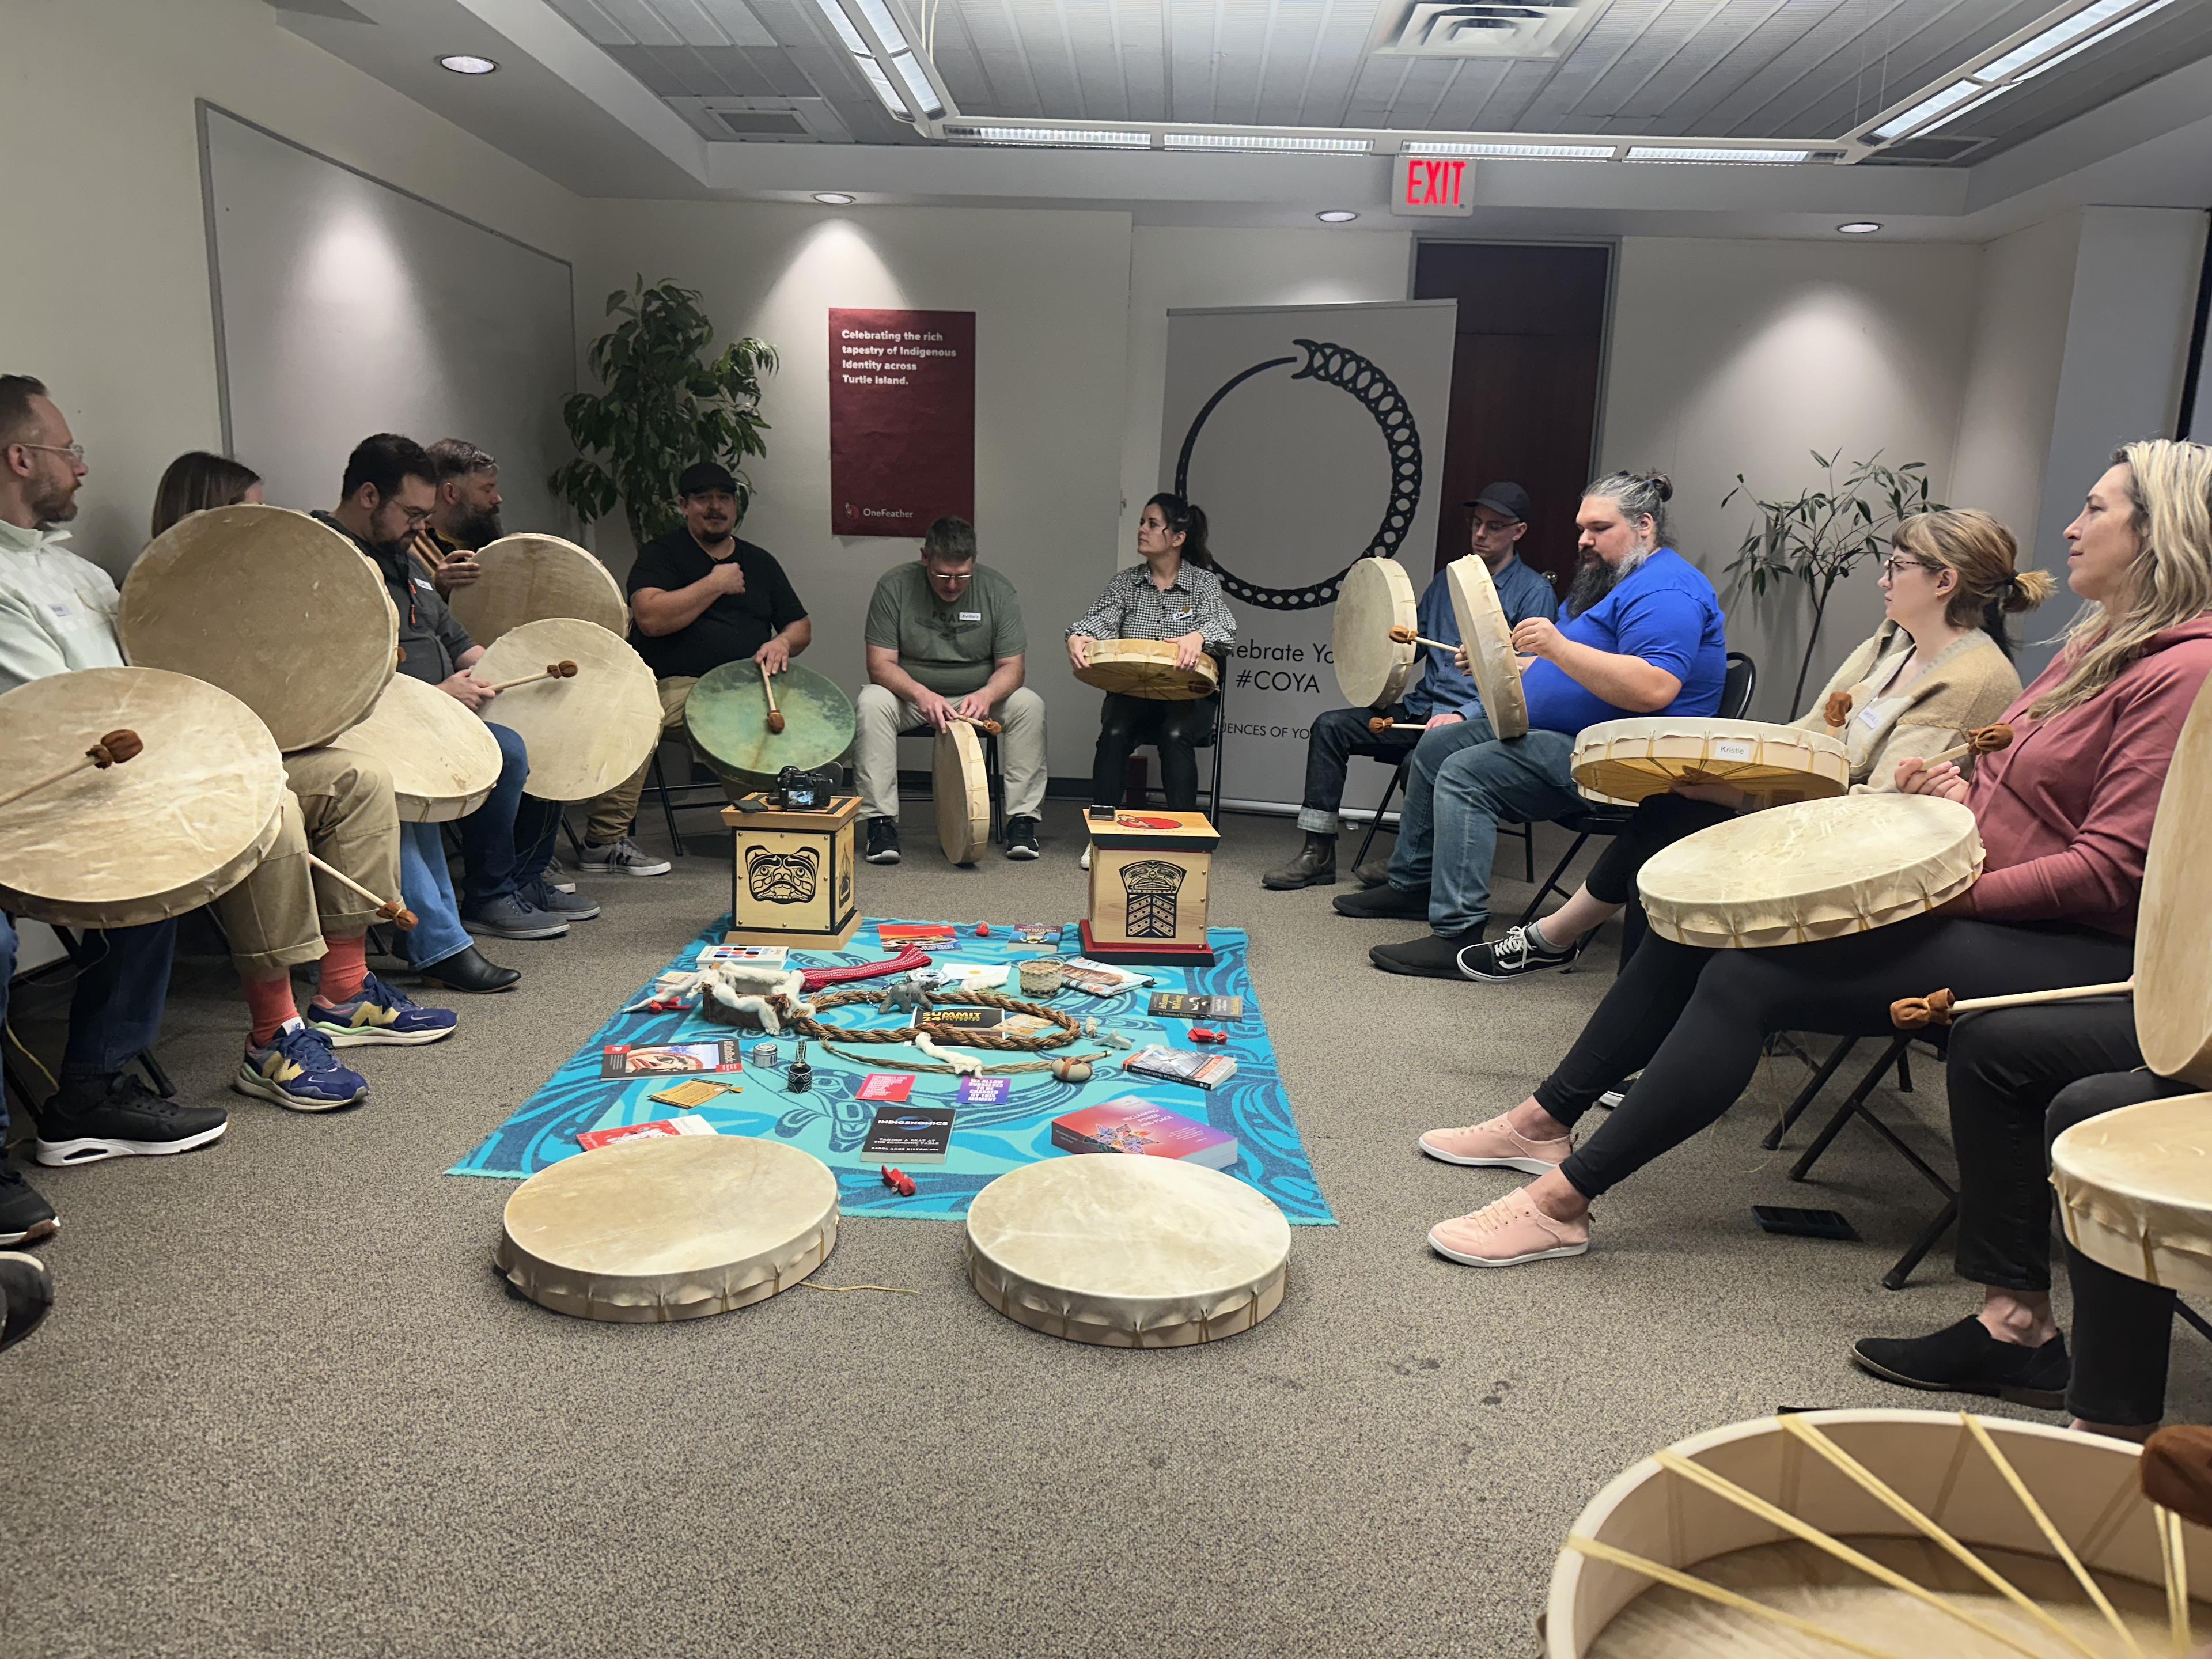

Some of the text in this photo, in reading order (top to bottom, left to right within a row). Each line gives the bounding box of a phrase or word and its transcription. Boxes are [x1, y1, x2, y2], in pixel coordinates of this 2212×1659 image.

[1406, 160, 1467, 206] EXIT
[842, 330, 943, 342] Celebrating the rich
[842, 346, 956, 358] tapestry of Indigenous
[842, 359, 917, 371] Identity across
[842, 375, 908, 385] Turtle Island.
[863, 508, 914, 517] OneFeather
[1232, 639, 1334, 664] ebrate Yo
[1236, 669, 1320, 693] #COYA
[1270, 726, 1288, 737] OF
[1292, 728, 1311, 739] YO
[1138, 1113, 1161, 1123] POWER
[1154, 1115, 1175, 1125] PLACE
